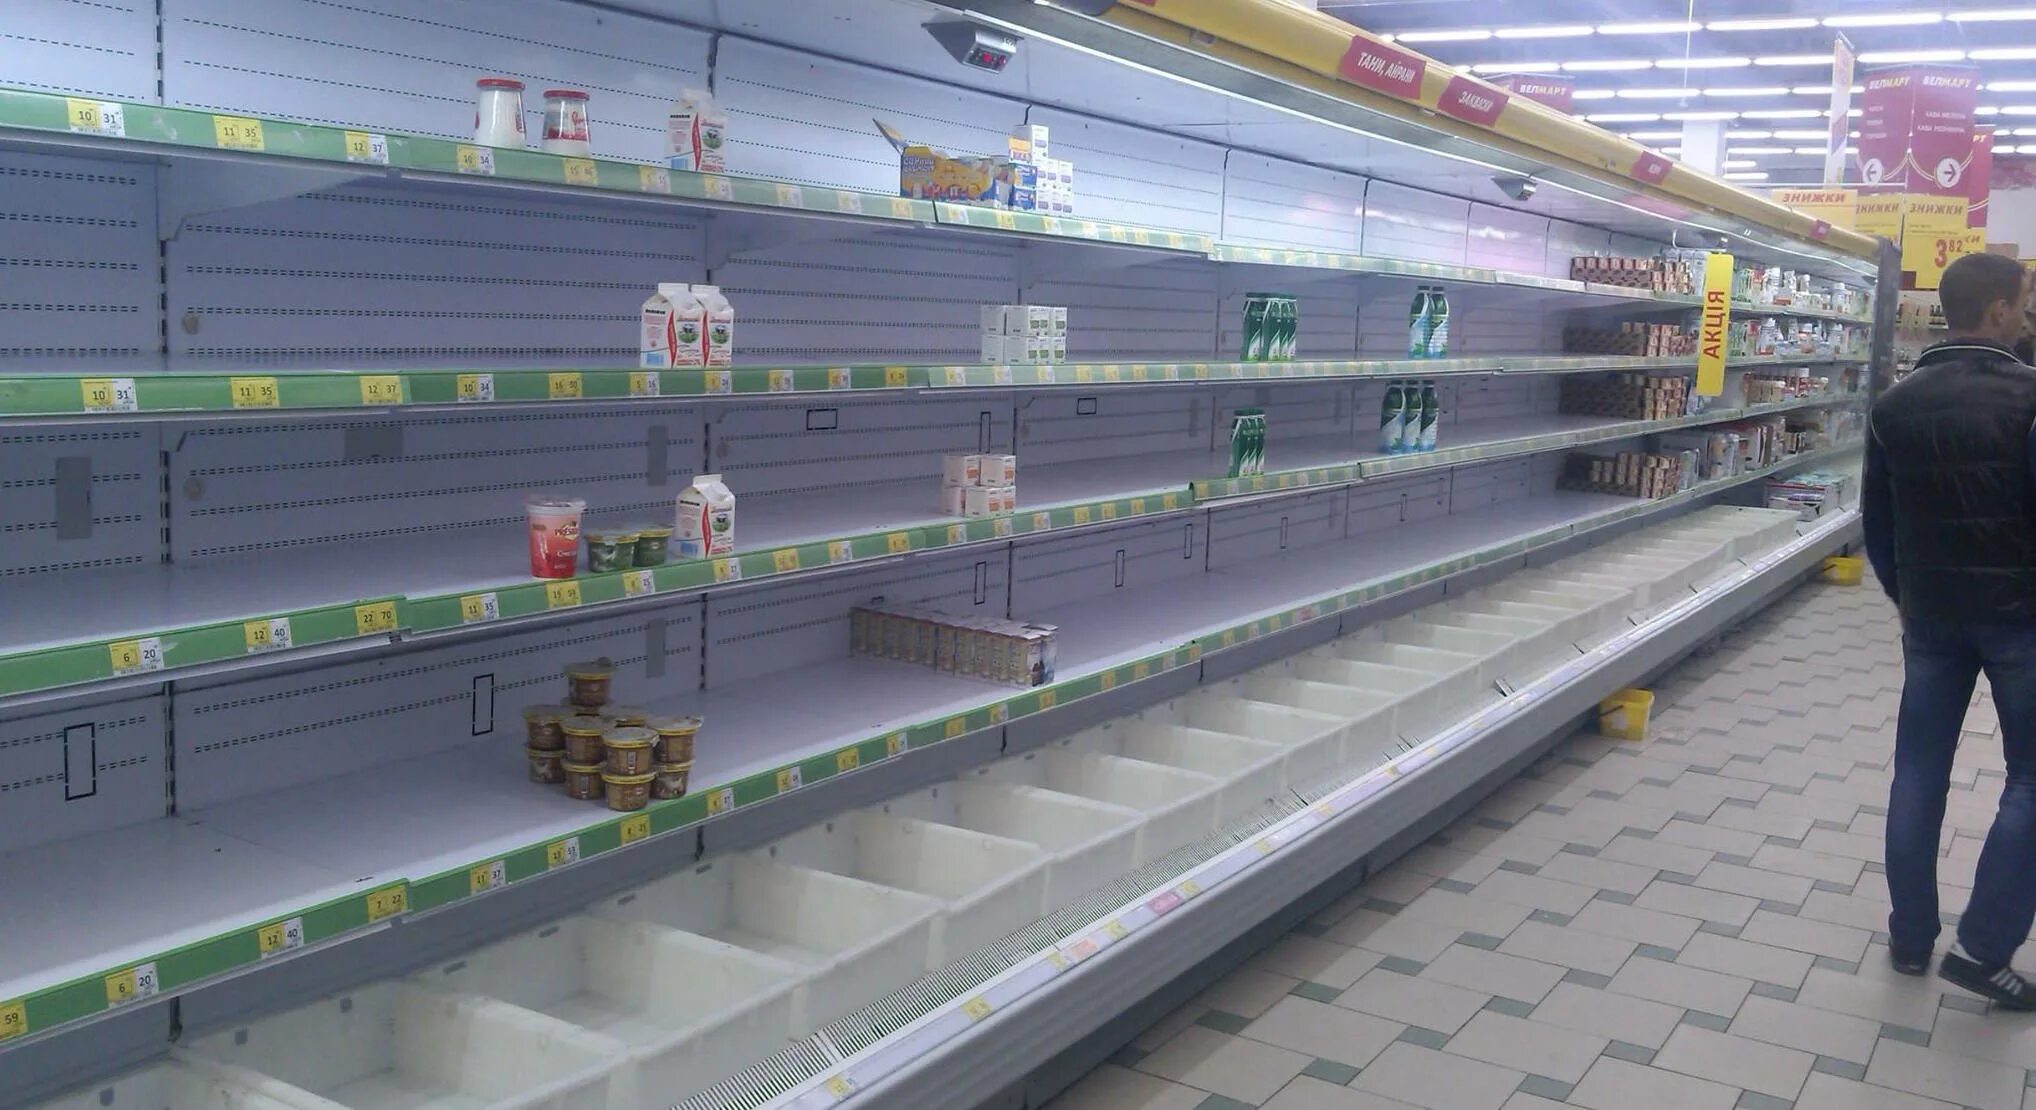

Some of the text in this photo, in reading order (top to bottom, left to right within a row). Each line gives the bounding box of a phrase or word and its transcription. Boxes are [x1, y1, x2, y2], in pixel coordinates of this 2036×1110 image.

[1519, 84, 1568, 97] ВЕЛМАРТ
[79, 110, 116, 124] 10 31
[224, 126, 257, 138] 11 35
[353, 142, 382, 153] 12 37
[1782, 192, 1847, 203] ЗНИЖКИ
[1909, 203, 1963, 215] ЗНИЖКИ
[1703, 291, 1725, 359] АКЦІЯ
[240, 386, 272, 396] 11 35
[368, 384, 396, 394] 12 37
[464, 382, 490, 393] 10 34
[92, 389, 129, 401] 10 31
[364, 610, 392, 623] 22 70
[254, 628, 285, 640] 12 40
[123, 649, 156, 662] 6 20
[268, 928, 298, 945] 12 40
[119, 975, 152, 993] 6 20
[5, 1012, 19, 1024] 59
